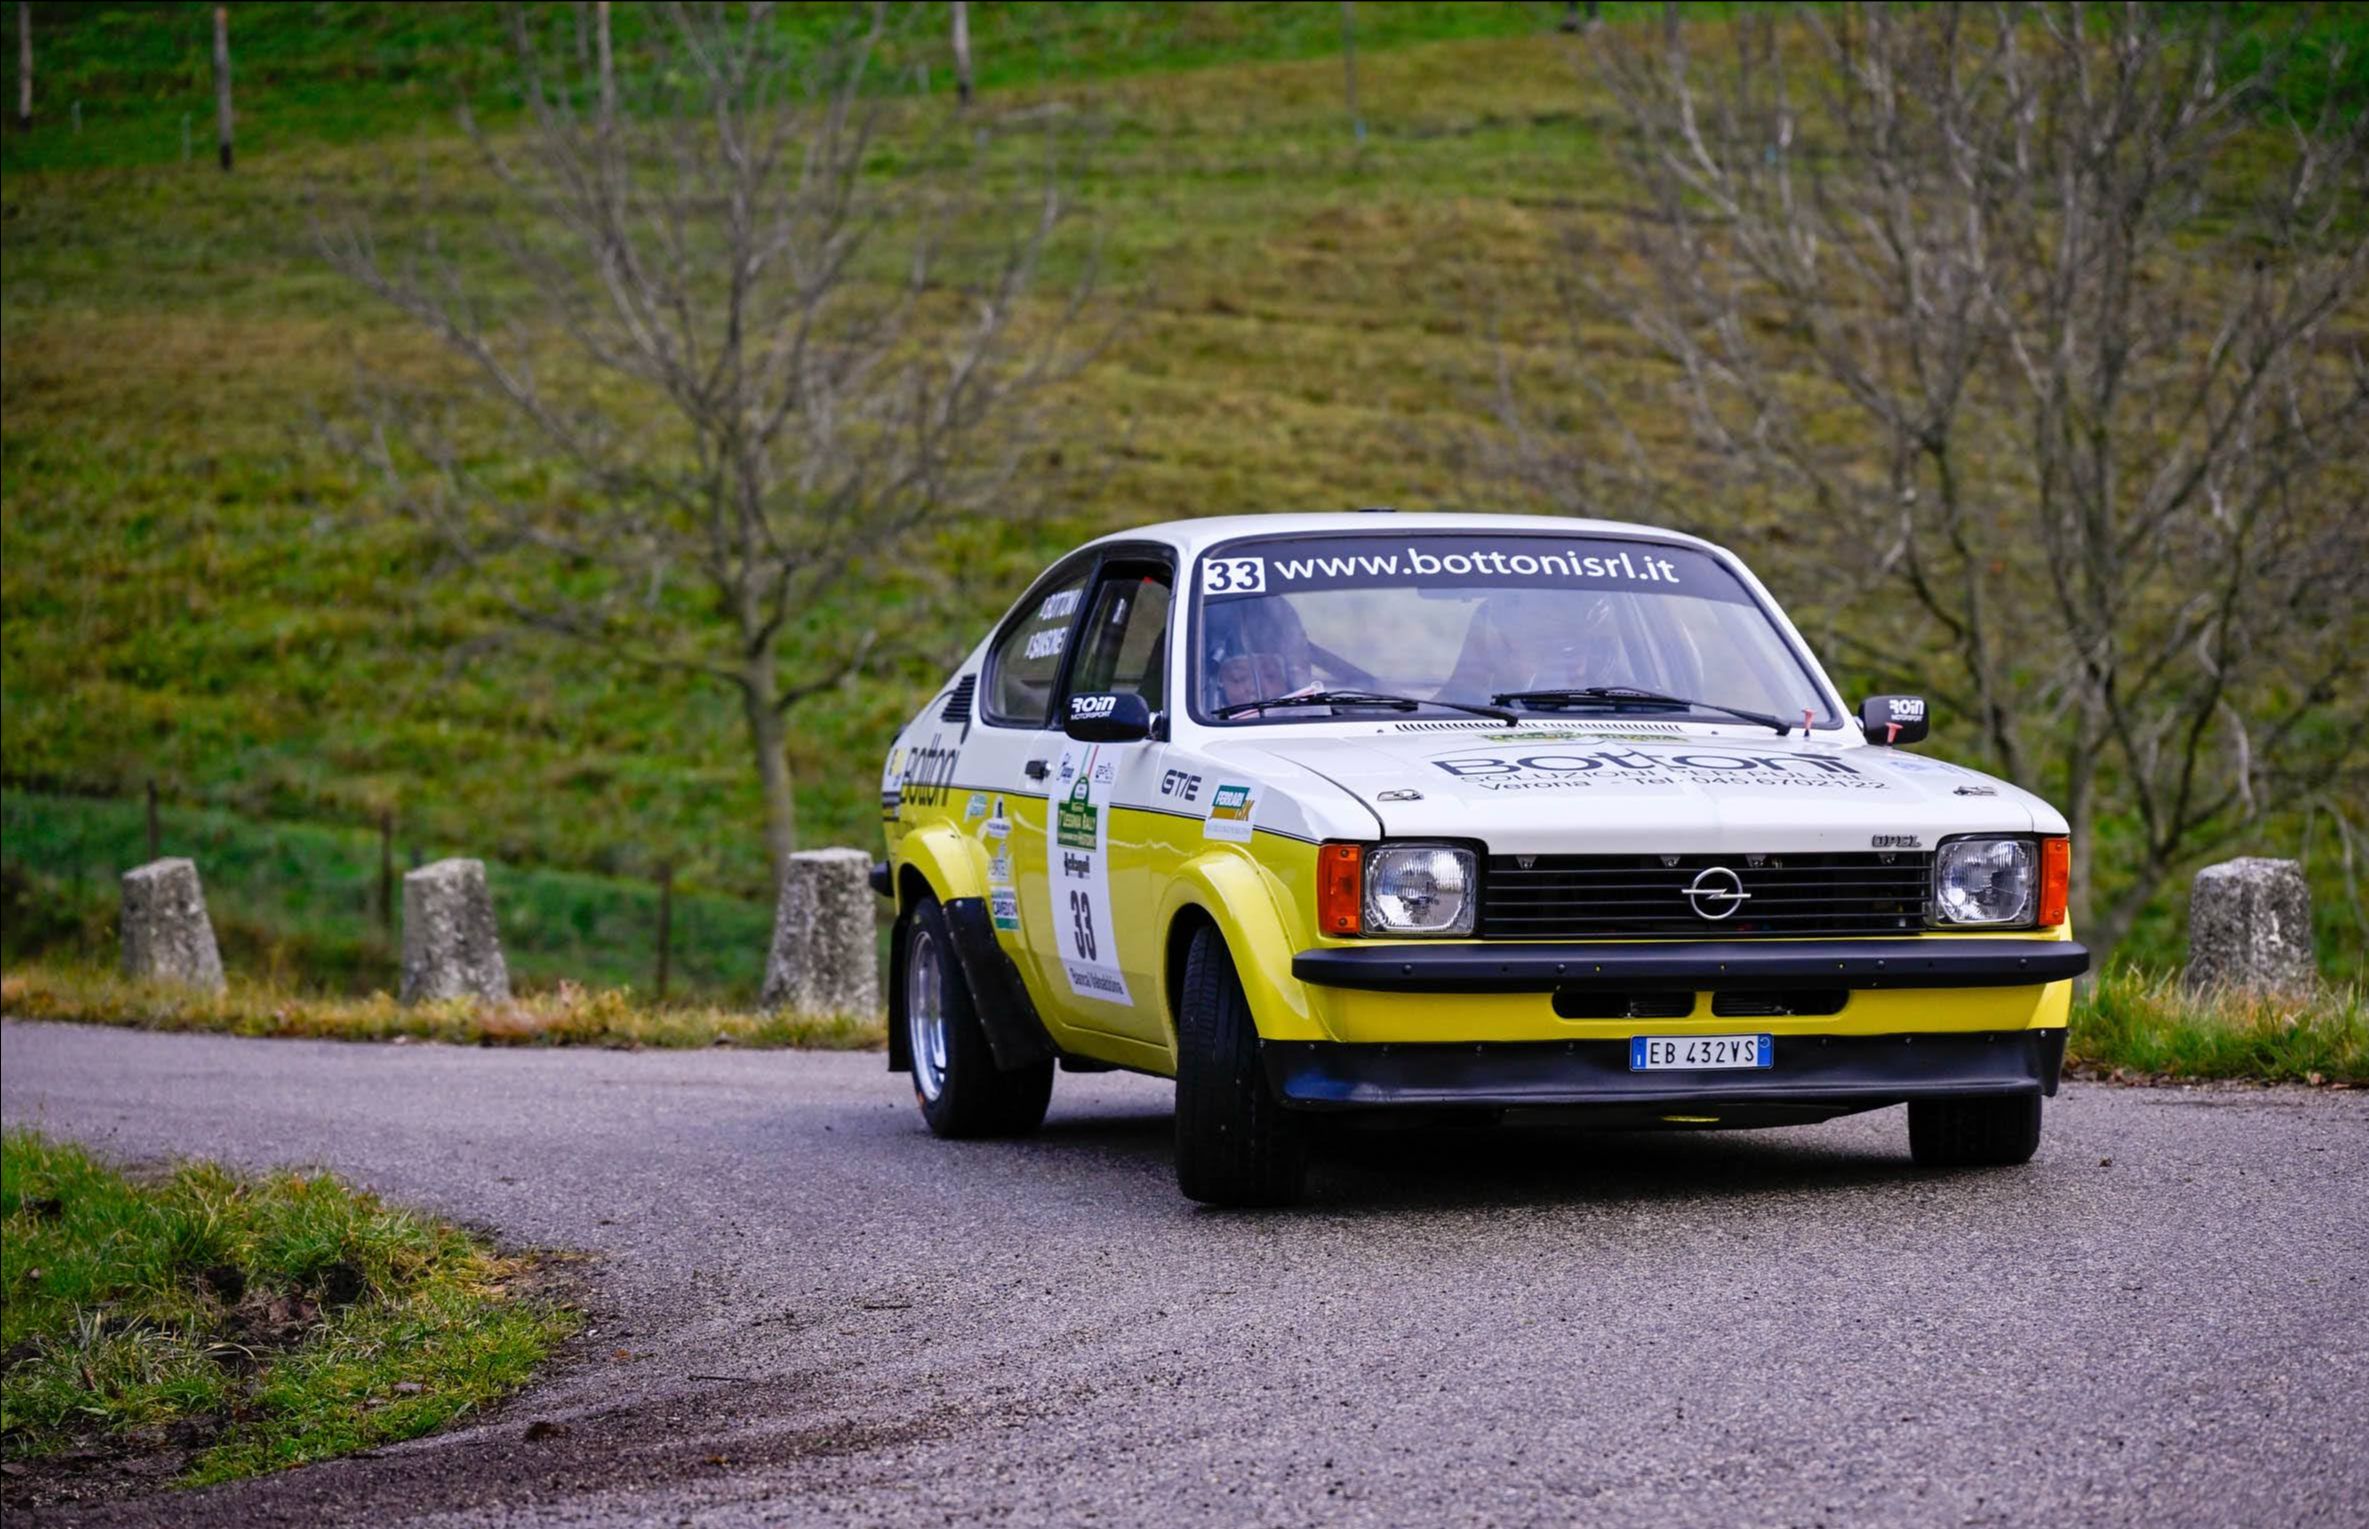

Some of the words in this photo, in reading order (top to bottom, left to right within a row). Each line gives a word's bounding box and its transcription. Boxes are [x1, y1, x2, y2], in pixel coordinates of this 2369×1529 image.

[1206, 559, 1263, 591] 33
[1273, 548, 1681, 584] www.bottonisrl.it
[1431, 748, 1861, 776] Bottoni
[1160, 768, 1202, 802] GT/E
[1477, 780, 1592, 791] Verona
[1755, 777, 1891, 790] 6702122
[1871, 834, 1922, 849] OPEL
[1069, 889, 1097, 962] 33
[1650, 1042, 1676, 1064] EB
[1686, 1040, 1756, 1063] 432VS
